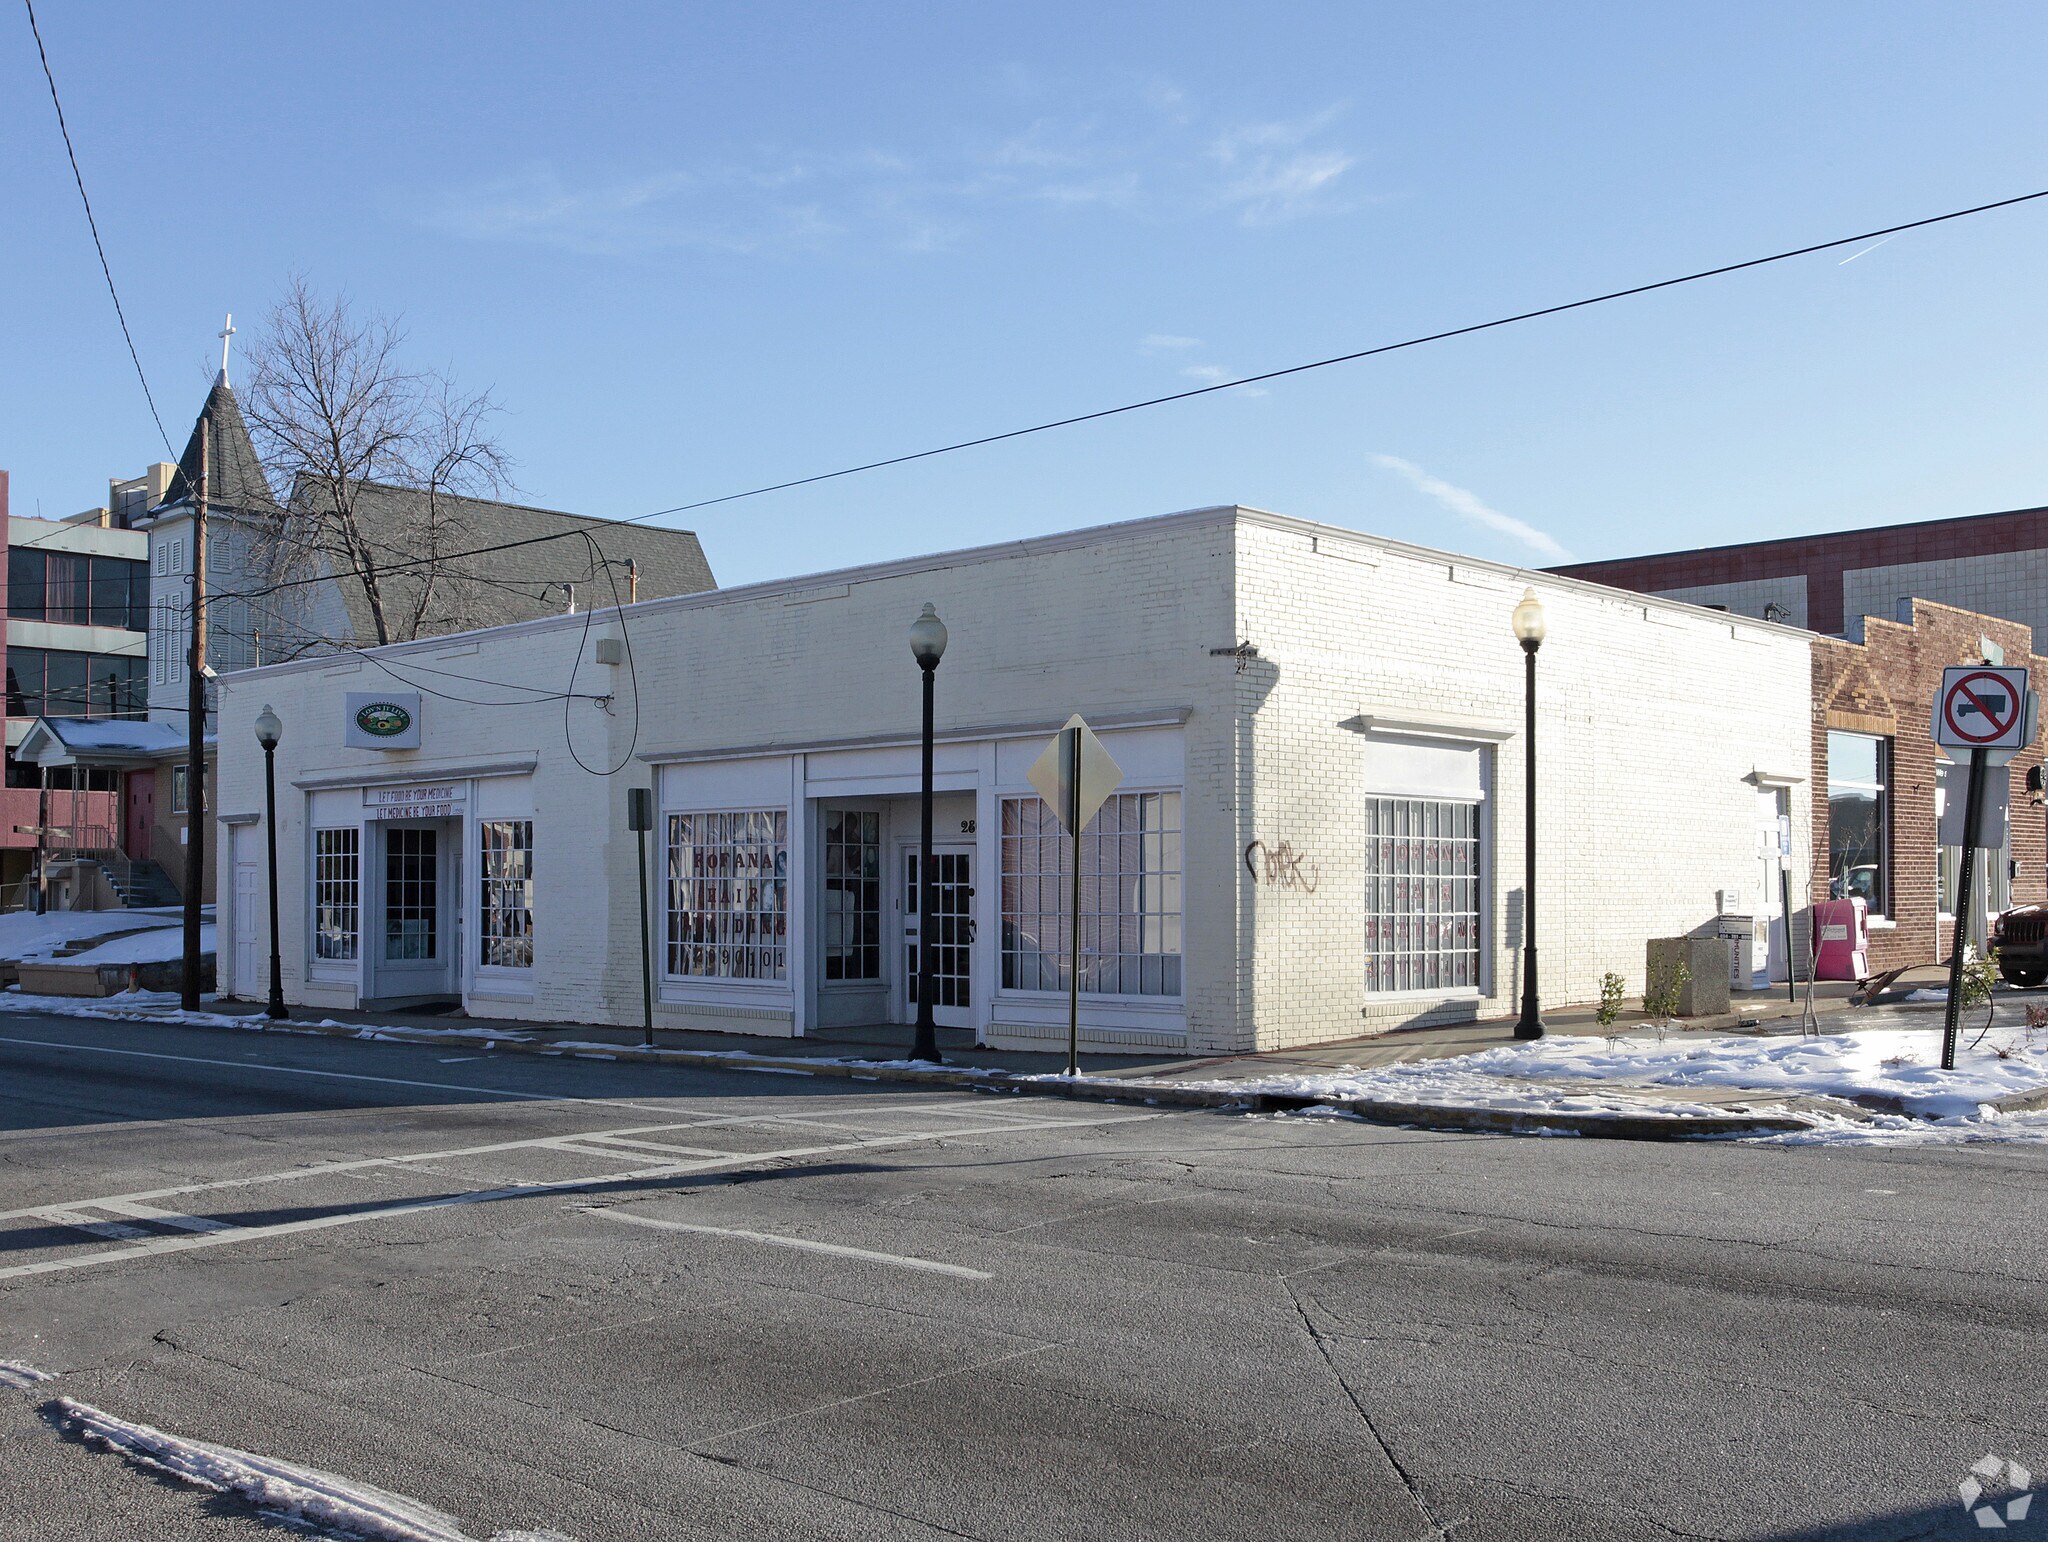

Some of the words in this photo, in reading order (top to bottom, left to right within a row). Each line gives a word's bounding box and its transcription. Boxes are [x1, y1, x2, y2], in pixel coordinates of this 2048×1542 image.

[391, 790, 405, 802] FOOD
[405, 790, 412, 801] BE
[413, 789, 427, 801] YOUR
[376, 808, 387, 819] LET
[387, 806, 412, 818] MEDICINE
[413, 806, 420, 817] BE
[421, 804, 436, 817] YOUR
[707, 887, 758, 903] HAIR
[1397, 881, 1451, 902] HAIR
[1366, 920, 1477, 939] BRAIDING
